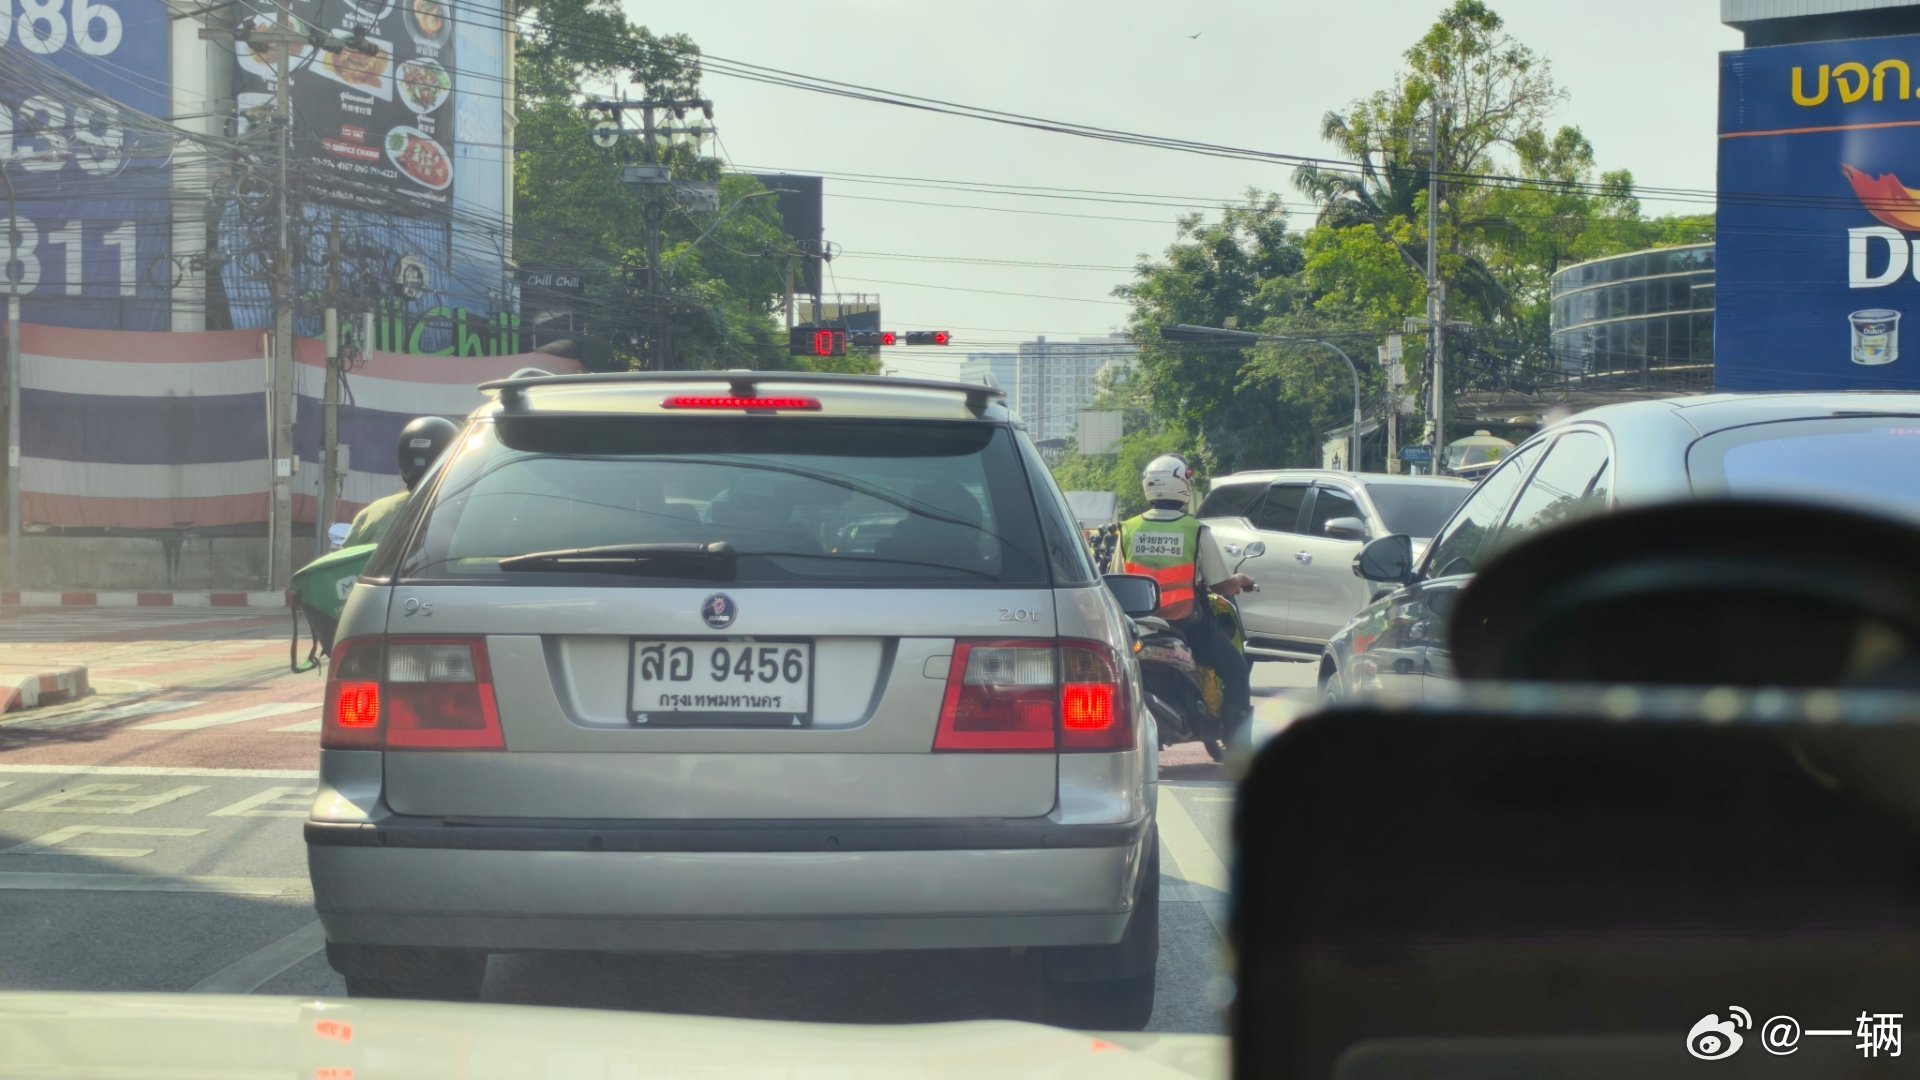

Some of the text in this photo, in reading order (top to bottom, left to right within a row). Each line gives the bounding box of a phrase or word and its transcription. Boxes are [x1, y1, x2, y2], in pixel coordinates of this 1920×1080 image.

[0, 0, 123, 56] 86
[1848, 226, 1920, 289] D
[409, 306, 520, 358] Chill
[640, 643, 804, 684] สอ 9456
[658, 693, 782, 711] กรุงเทพมหานคร
